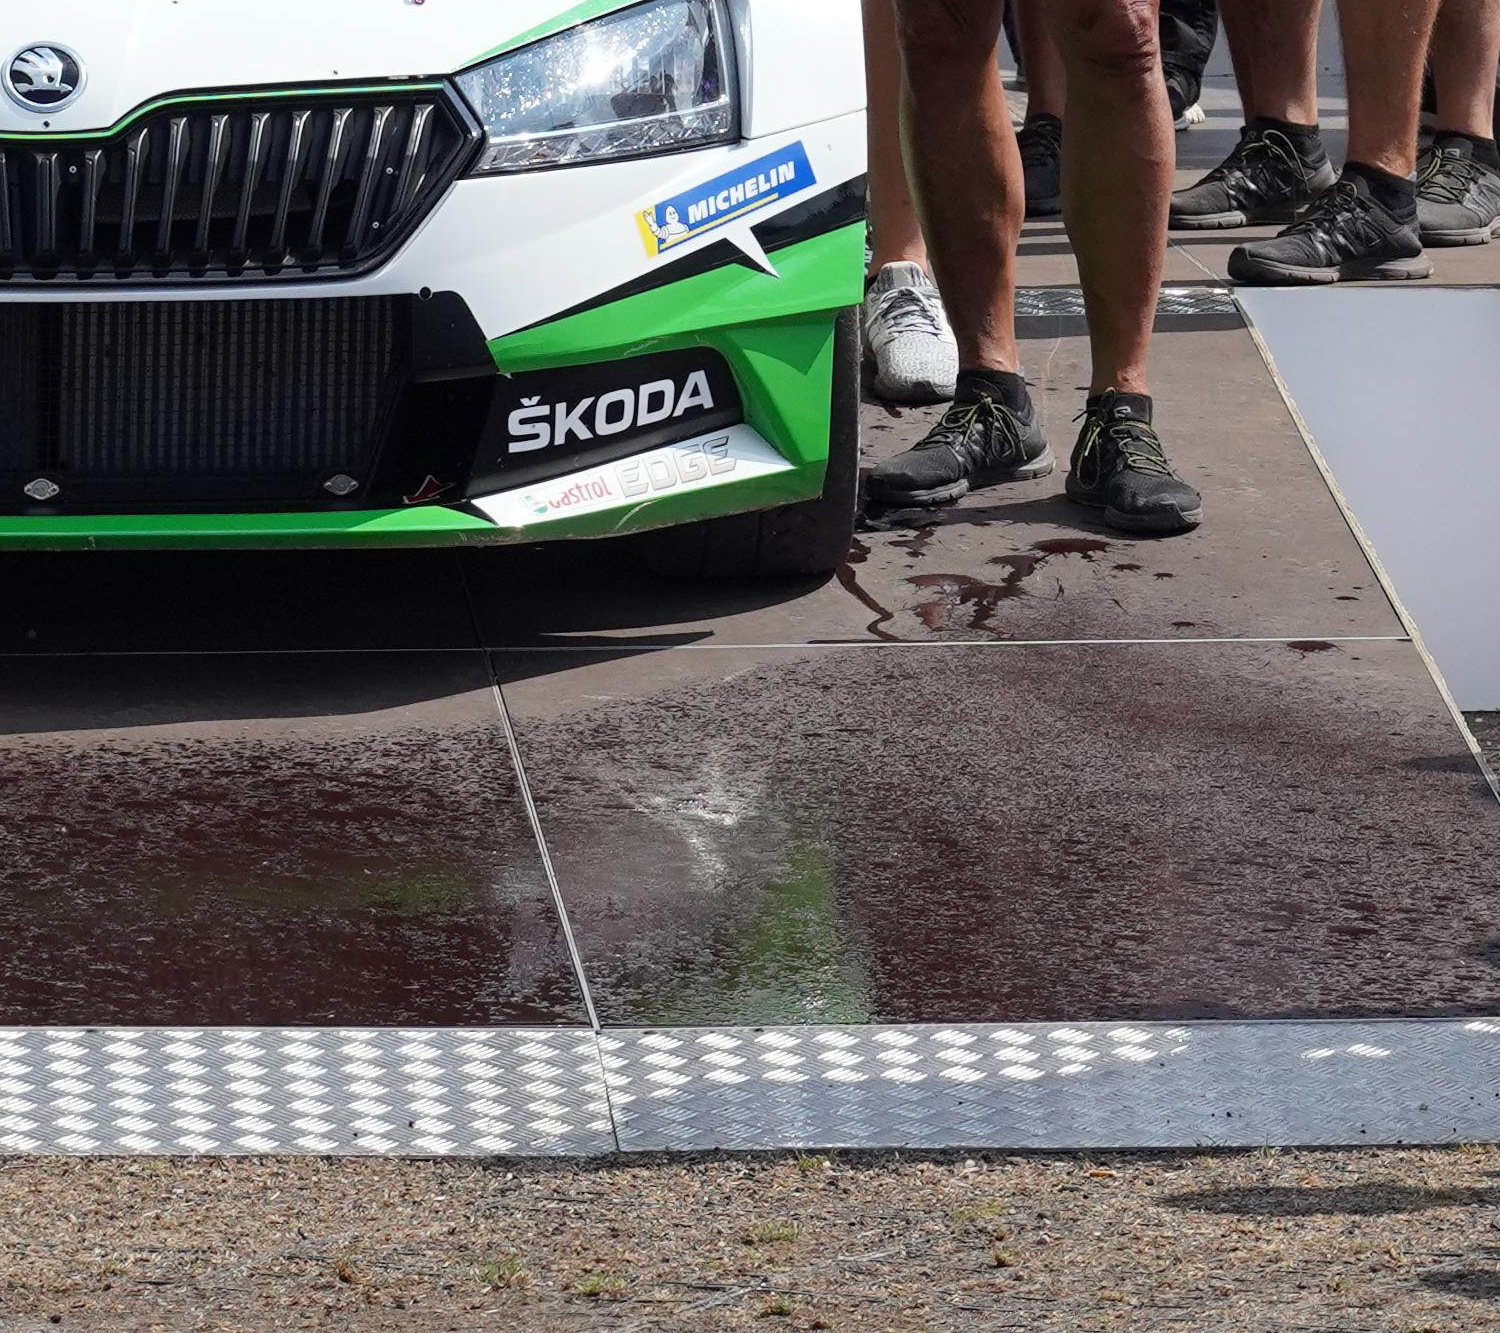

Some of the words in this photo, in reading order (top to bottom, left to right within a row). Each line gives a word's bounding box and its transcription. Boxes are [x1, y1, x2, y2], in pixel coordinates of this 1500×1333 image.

[685, 160, 796, 225] MICHELIN
[506, 369, 715, 455] ŠKODA
[620, 434, 737, 498] EDGE
